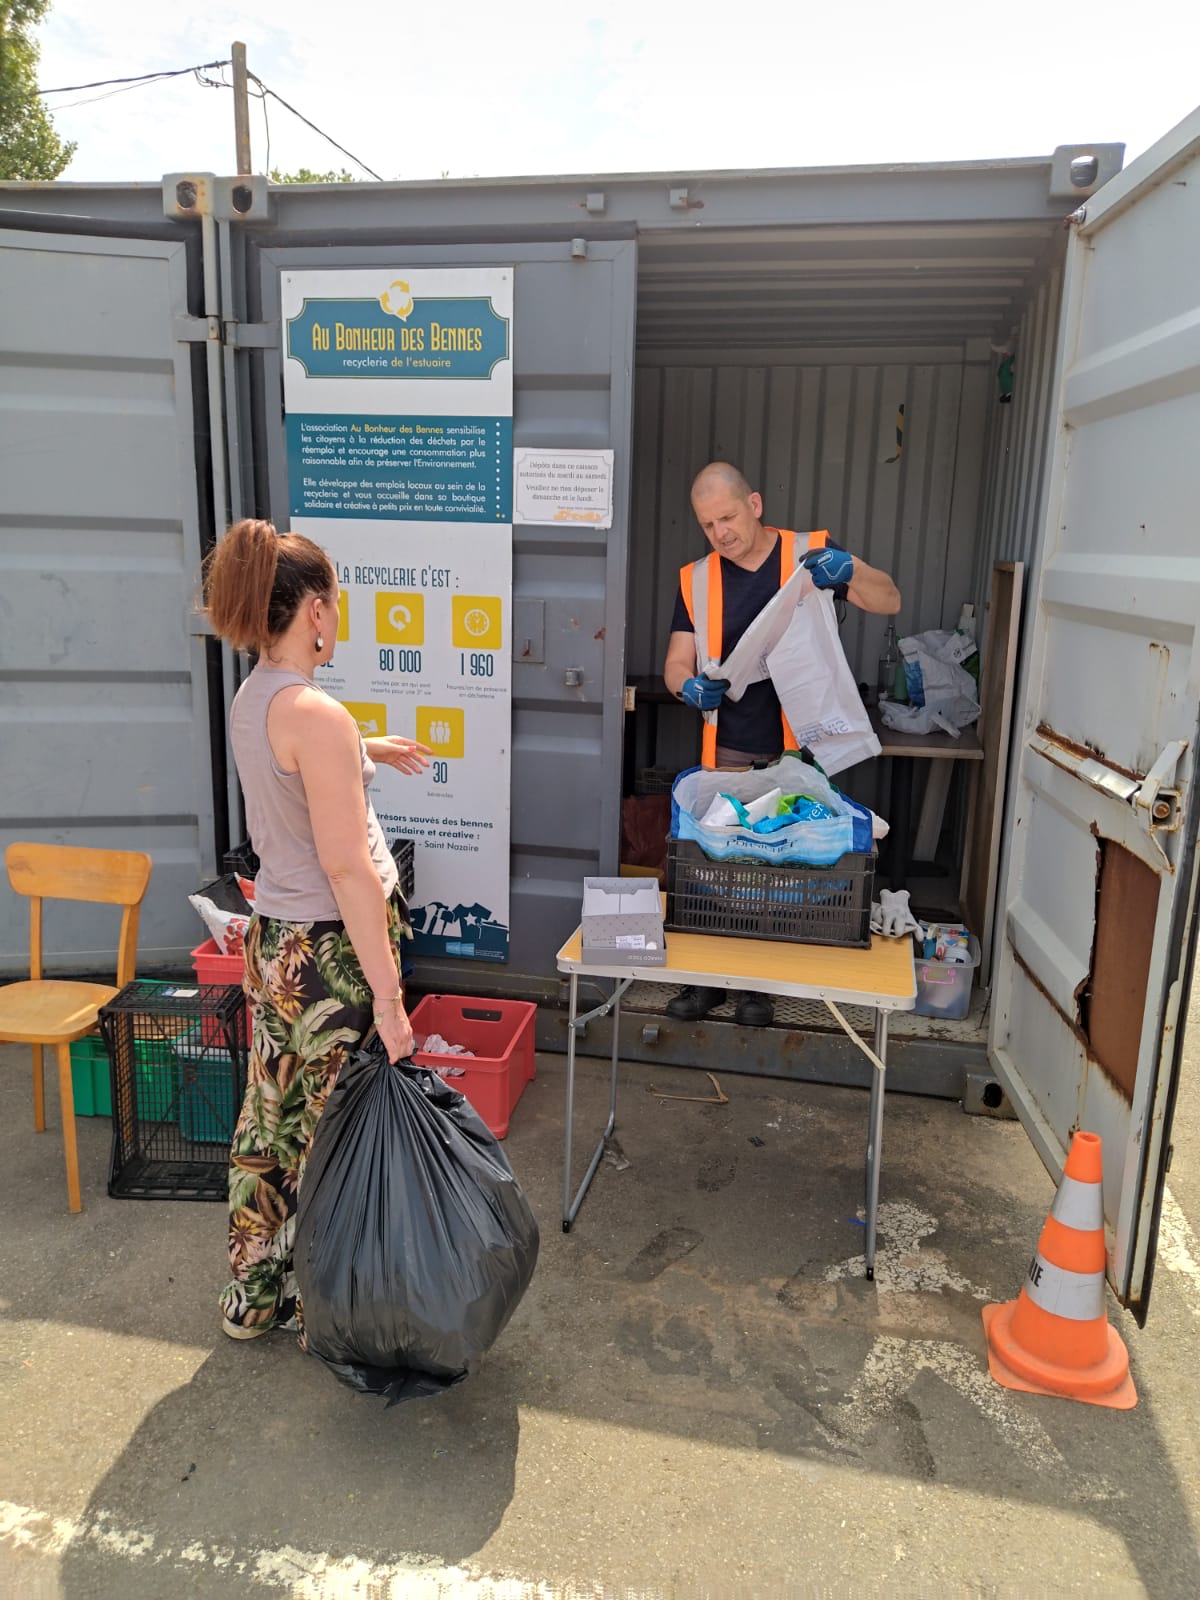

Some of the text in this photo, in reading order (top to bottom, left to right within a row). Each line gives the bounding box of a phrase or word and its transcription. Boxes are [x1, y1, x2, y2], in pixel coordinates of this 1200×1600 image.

[343, 356, 451, 369] recyclerie de l'estuaire
[301, 423, 486, 435] L'association Au Bonheur des Bennes sensibilise
[301, 434, 486, 447] les citoyens à la réduction des déchets par le
[302, 446, 335, 455] réemploi
[348, 449, 389, 457] encourage
[409, 448, 467, 457] consommation
[469, 449, 486, 458] plus
[303, 457, 346, 466] raisonnable
[348, 457, 363, 466] afin
[365, 458, 375, 466] de
[377, 458, 411, 468] préserver
[529, 462, 550, 470] Dépôts
[303, 478, 317, 486] Elle
[319, 478, 357, 489] développe
[360, 480, 373, 488] des
[376, 480, 405, 490] emplois
[408, 481, 432, 489] locaux
[448, 482, 463, 490] sein
[466, 482, 475, 490] de
[478, 482, 486, 491] la
[304, 490, 338, 499] recyclerie
[377, 492, 410, 500] accueille
[414, 492, 433, 500] dans
[452, 494, 486, 503] boutique
[304, 500, 334, 508] solidaire
[335, 501, 342, 509] et
[344, 501, 371, 510] créative
[372, 502, 378, 510] à
[379, 502, 398, 512] petits
[399, 503, 413, 512] prix
[425, 504, 443, 512] toute
[445, 504, 486, 513] convivialité.
[336, 562, 350, 583] LA
[355, 566, 416, 587] RECYCLERIE
[421, 565, 451, 588] C'EST
[379, 649, 422, 673] 80 000
[470, 654, 494, 677] 960
[433, 761, 448, 784] 30
[376, 813, 494, 829] trésors sauvés des bennes
[386, 825, 425, 836] solidaire
[428, 828, 437, 837] et
[439, 828, 474, 840] créative
[424, 841, 444, 850] Saint
[447, 841, 479, 853] Nazaire
